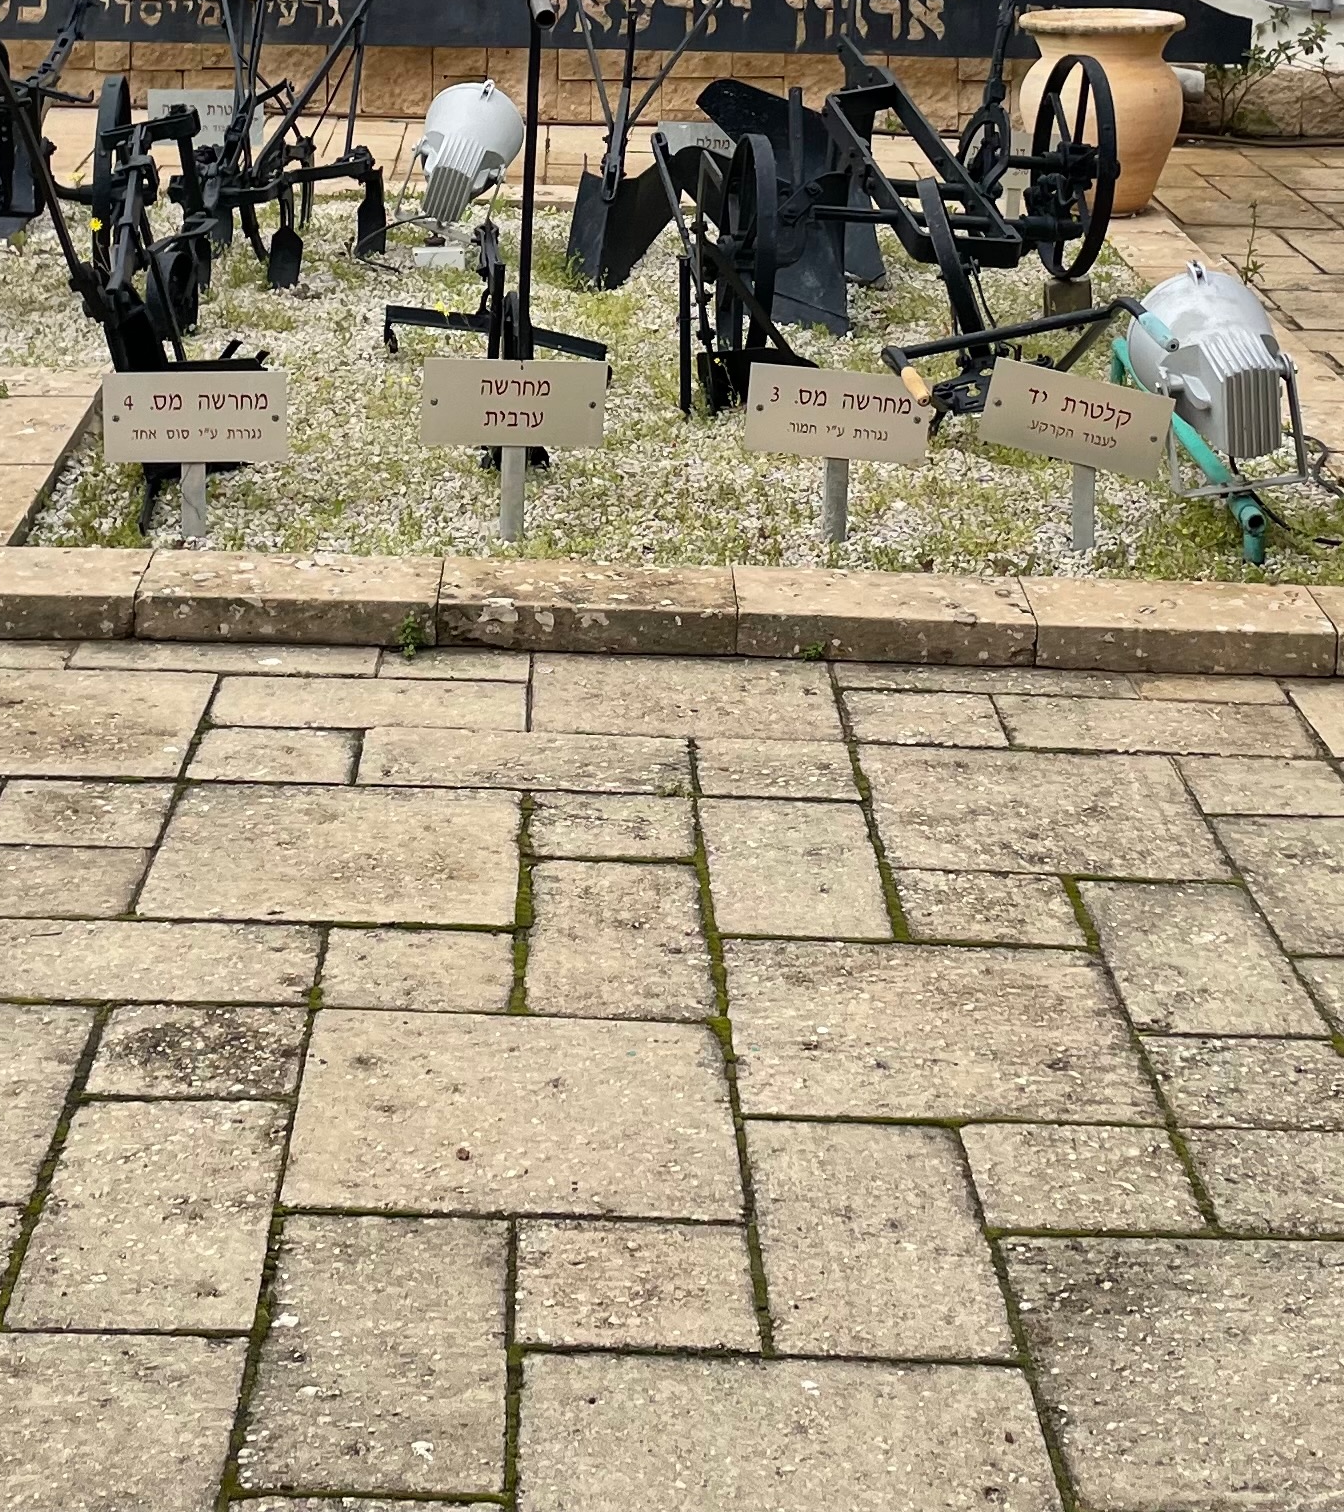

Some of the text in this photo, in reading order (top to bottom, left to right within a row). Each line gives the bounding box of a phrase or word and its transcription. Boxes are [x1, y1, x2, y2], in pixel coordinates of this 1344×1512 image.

[480, 379, 551, 397] מחרשה
[123, 393, 268, 411] מחרשה מס. 4
[769, 386, 912, 415] מחרשה מס. 3
[1028, 387, 1132, 430] קלטרת יד
[483, 411, 544, 429] ערבית
[166, 429, 190, 440] סוס
[226, 428, 262, 440] נגררת
[852, 428, 888, 441] נגררת
[1083, 432, 1117, 449] לעבוד
